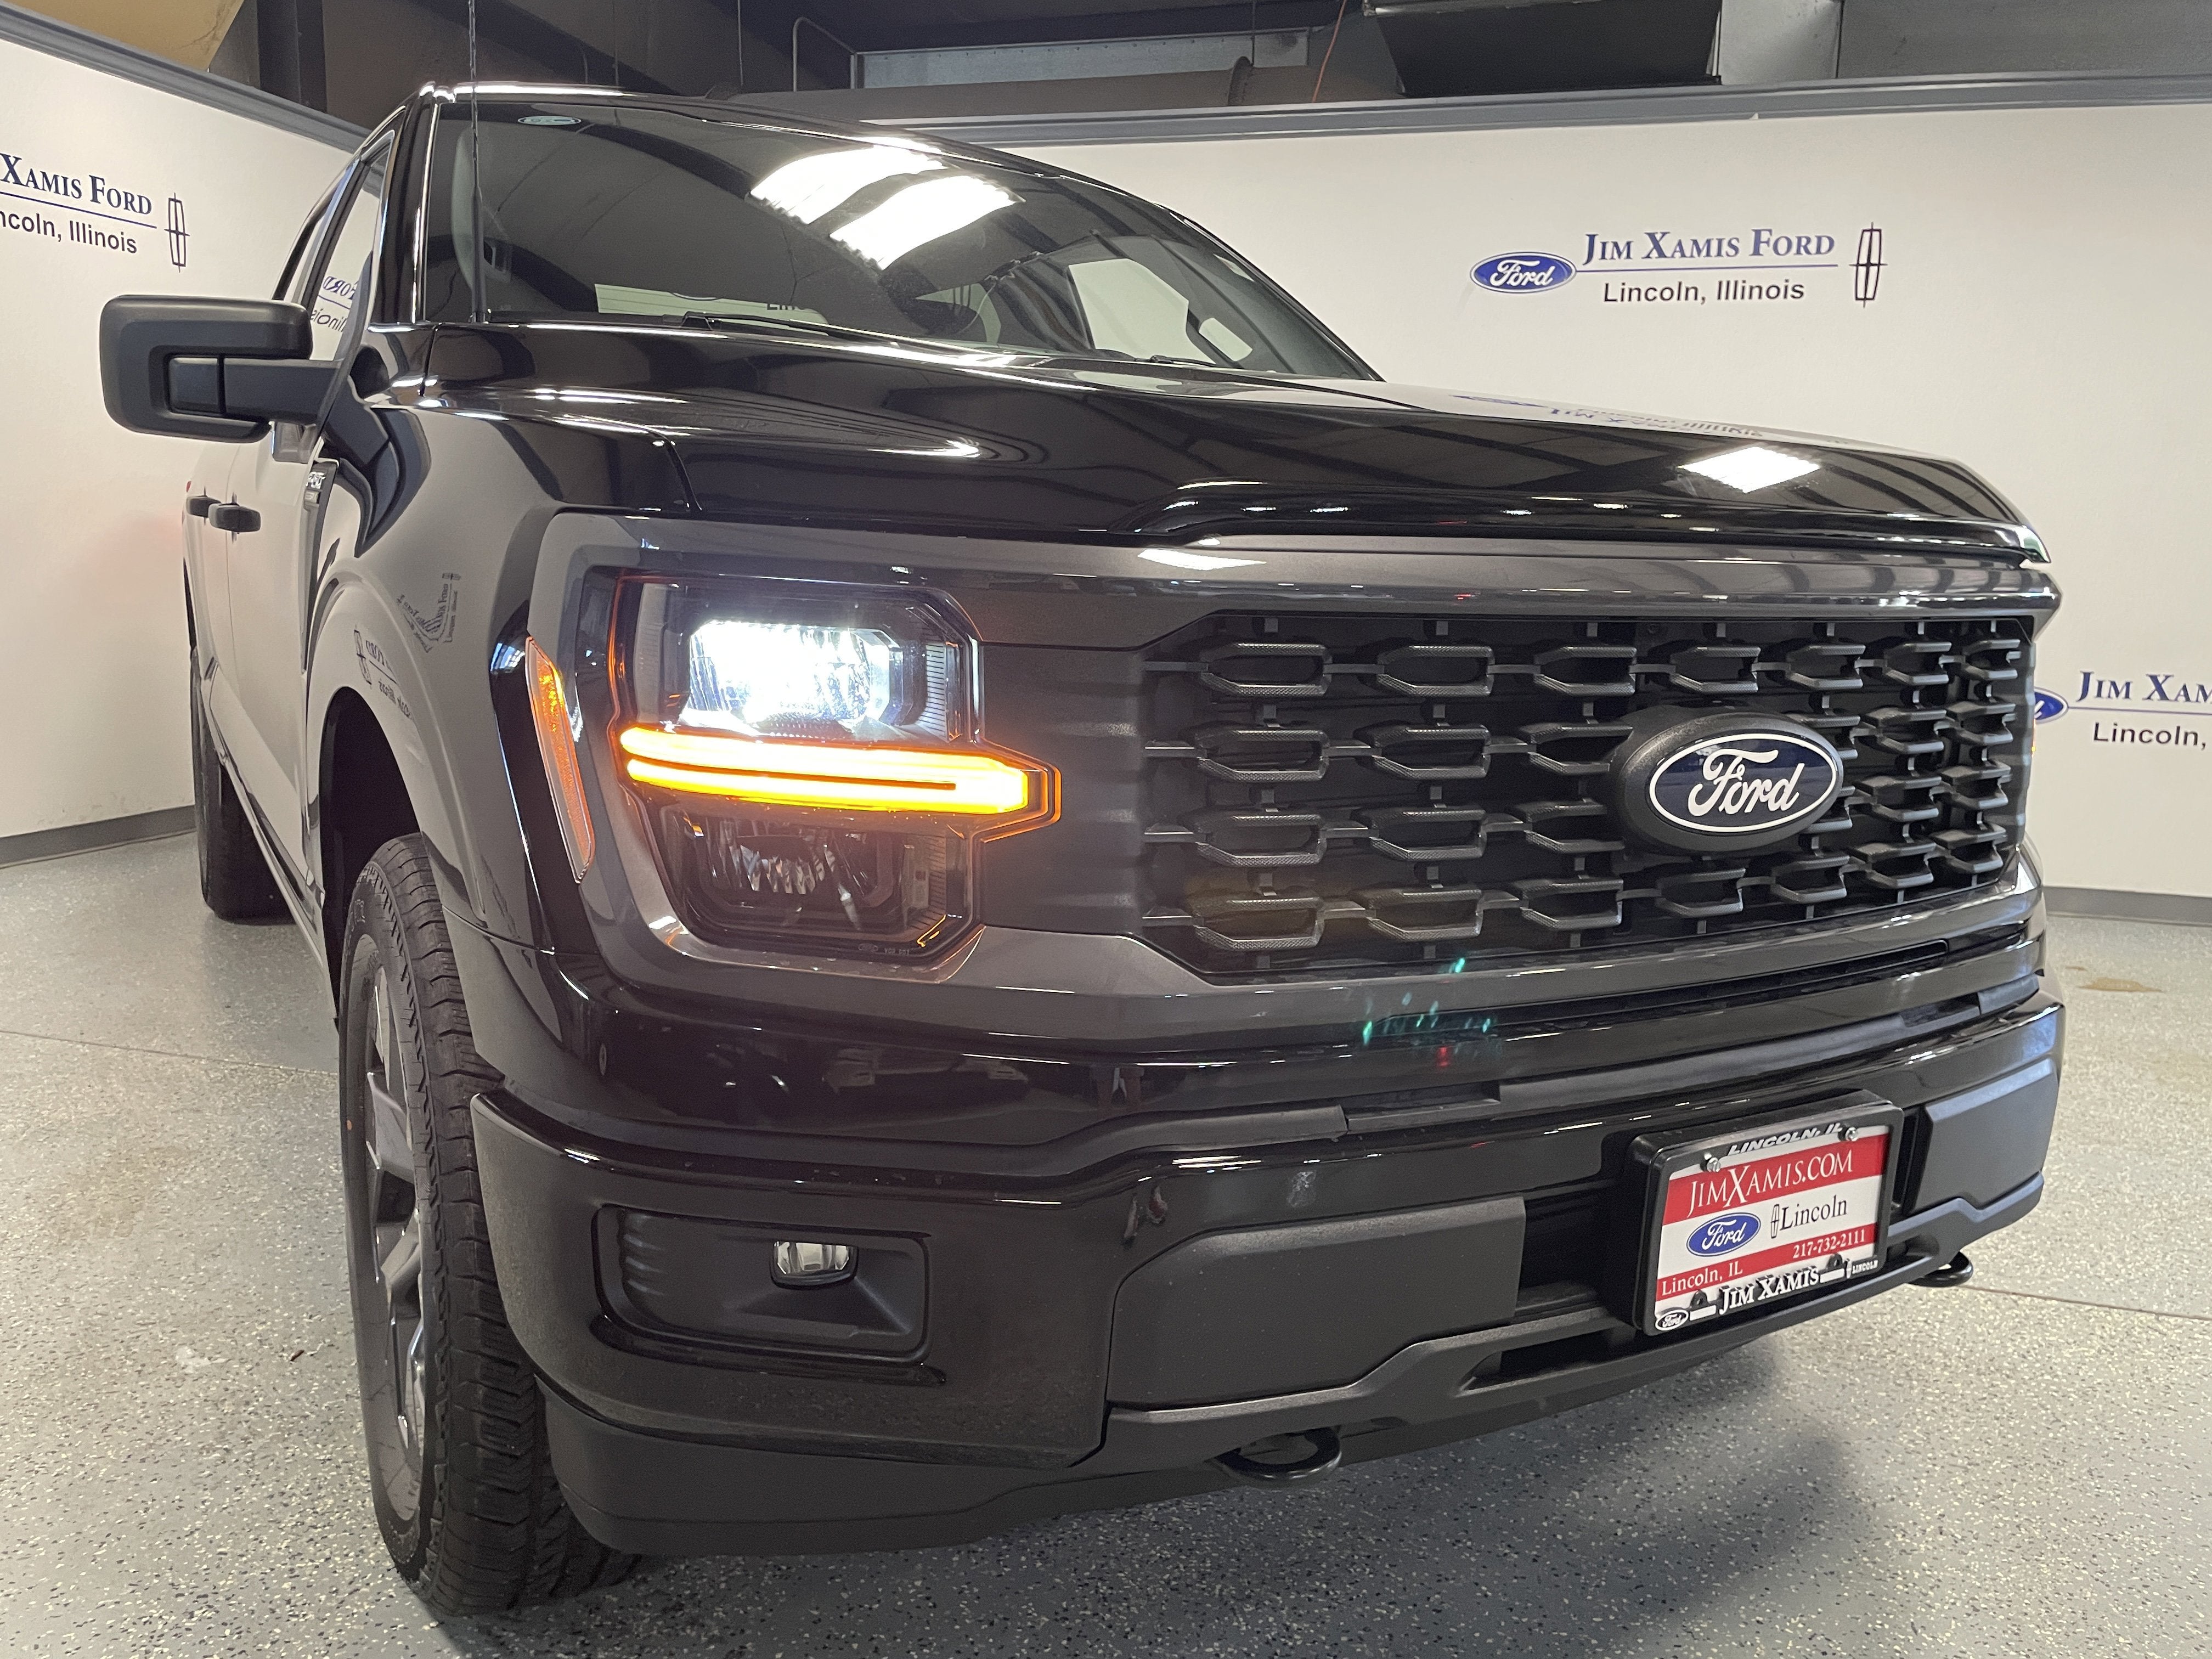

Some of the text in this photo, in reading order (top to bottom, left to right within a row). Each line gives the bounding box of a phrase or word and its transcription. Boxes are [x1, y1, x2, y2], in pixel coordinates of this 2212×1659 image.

[89, 174, 152, 215] FORD
[70, 221, 137, 253] Illinois
[1583, 228, 1835, 266] JIM XAMIS FORD
[1489, 259, 1556, 287] Ford
[1604, 279, 1805, 305] Lincoln, Illinois
[2076, 670, 2134, 703] JIM
[2093, 722, 2206, 751] Lincoln,
[1688, 748, 1805, 817] Ford
[1702, 1195, 1848, 1250] Ford Lincoln
[1792, 1229, 1865, 1259] 217-732-2111
[1662, 1261, 1743, 1296] Lincoln, IL
[1851, 1260, 1879, 1274] LINCOLN
[1719, 1267, 1819, 1316] JIM XAMIS
[1662, 1313, 1683, 1328] Ford
